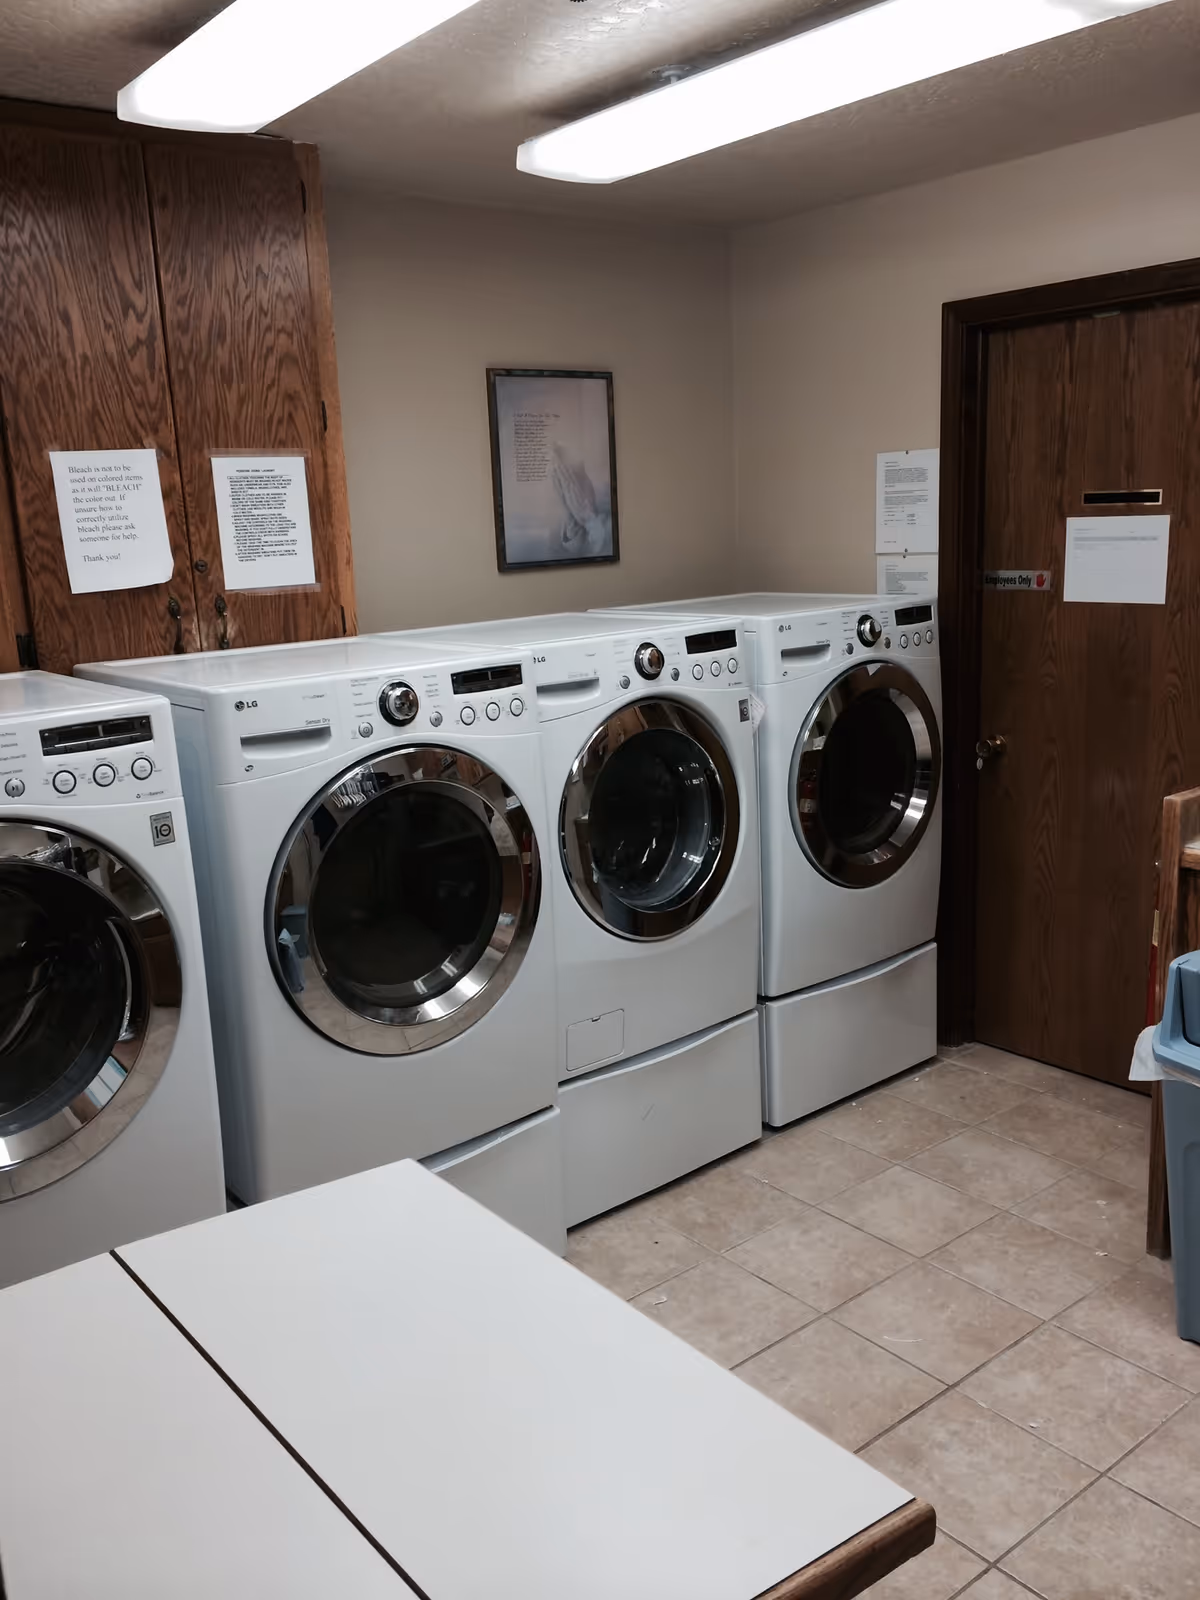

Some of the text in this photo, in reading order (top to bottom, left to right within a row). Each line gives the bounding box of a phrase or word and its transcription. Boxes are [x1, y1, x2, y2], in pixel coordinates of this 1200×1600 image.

[68, 465, 92, 473] Bleach
[98, 474, 123, 483] colored
[76, 515, 106, 523] correctly
[77, 525, 100, 533] bleach
[102, 524, 123, 533] please
[111, 533, 121, 541] for
[82, 553, 121, 563] Thank you!
[985, 575, 1032, 588] Employees Only
[246, 700, 258, 709] LG
